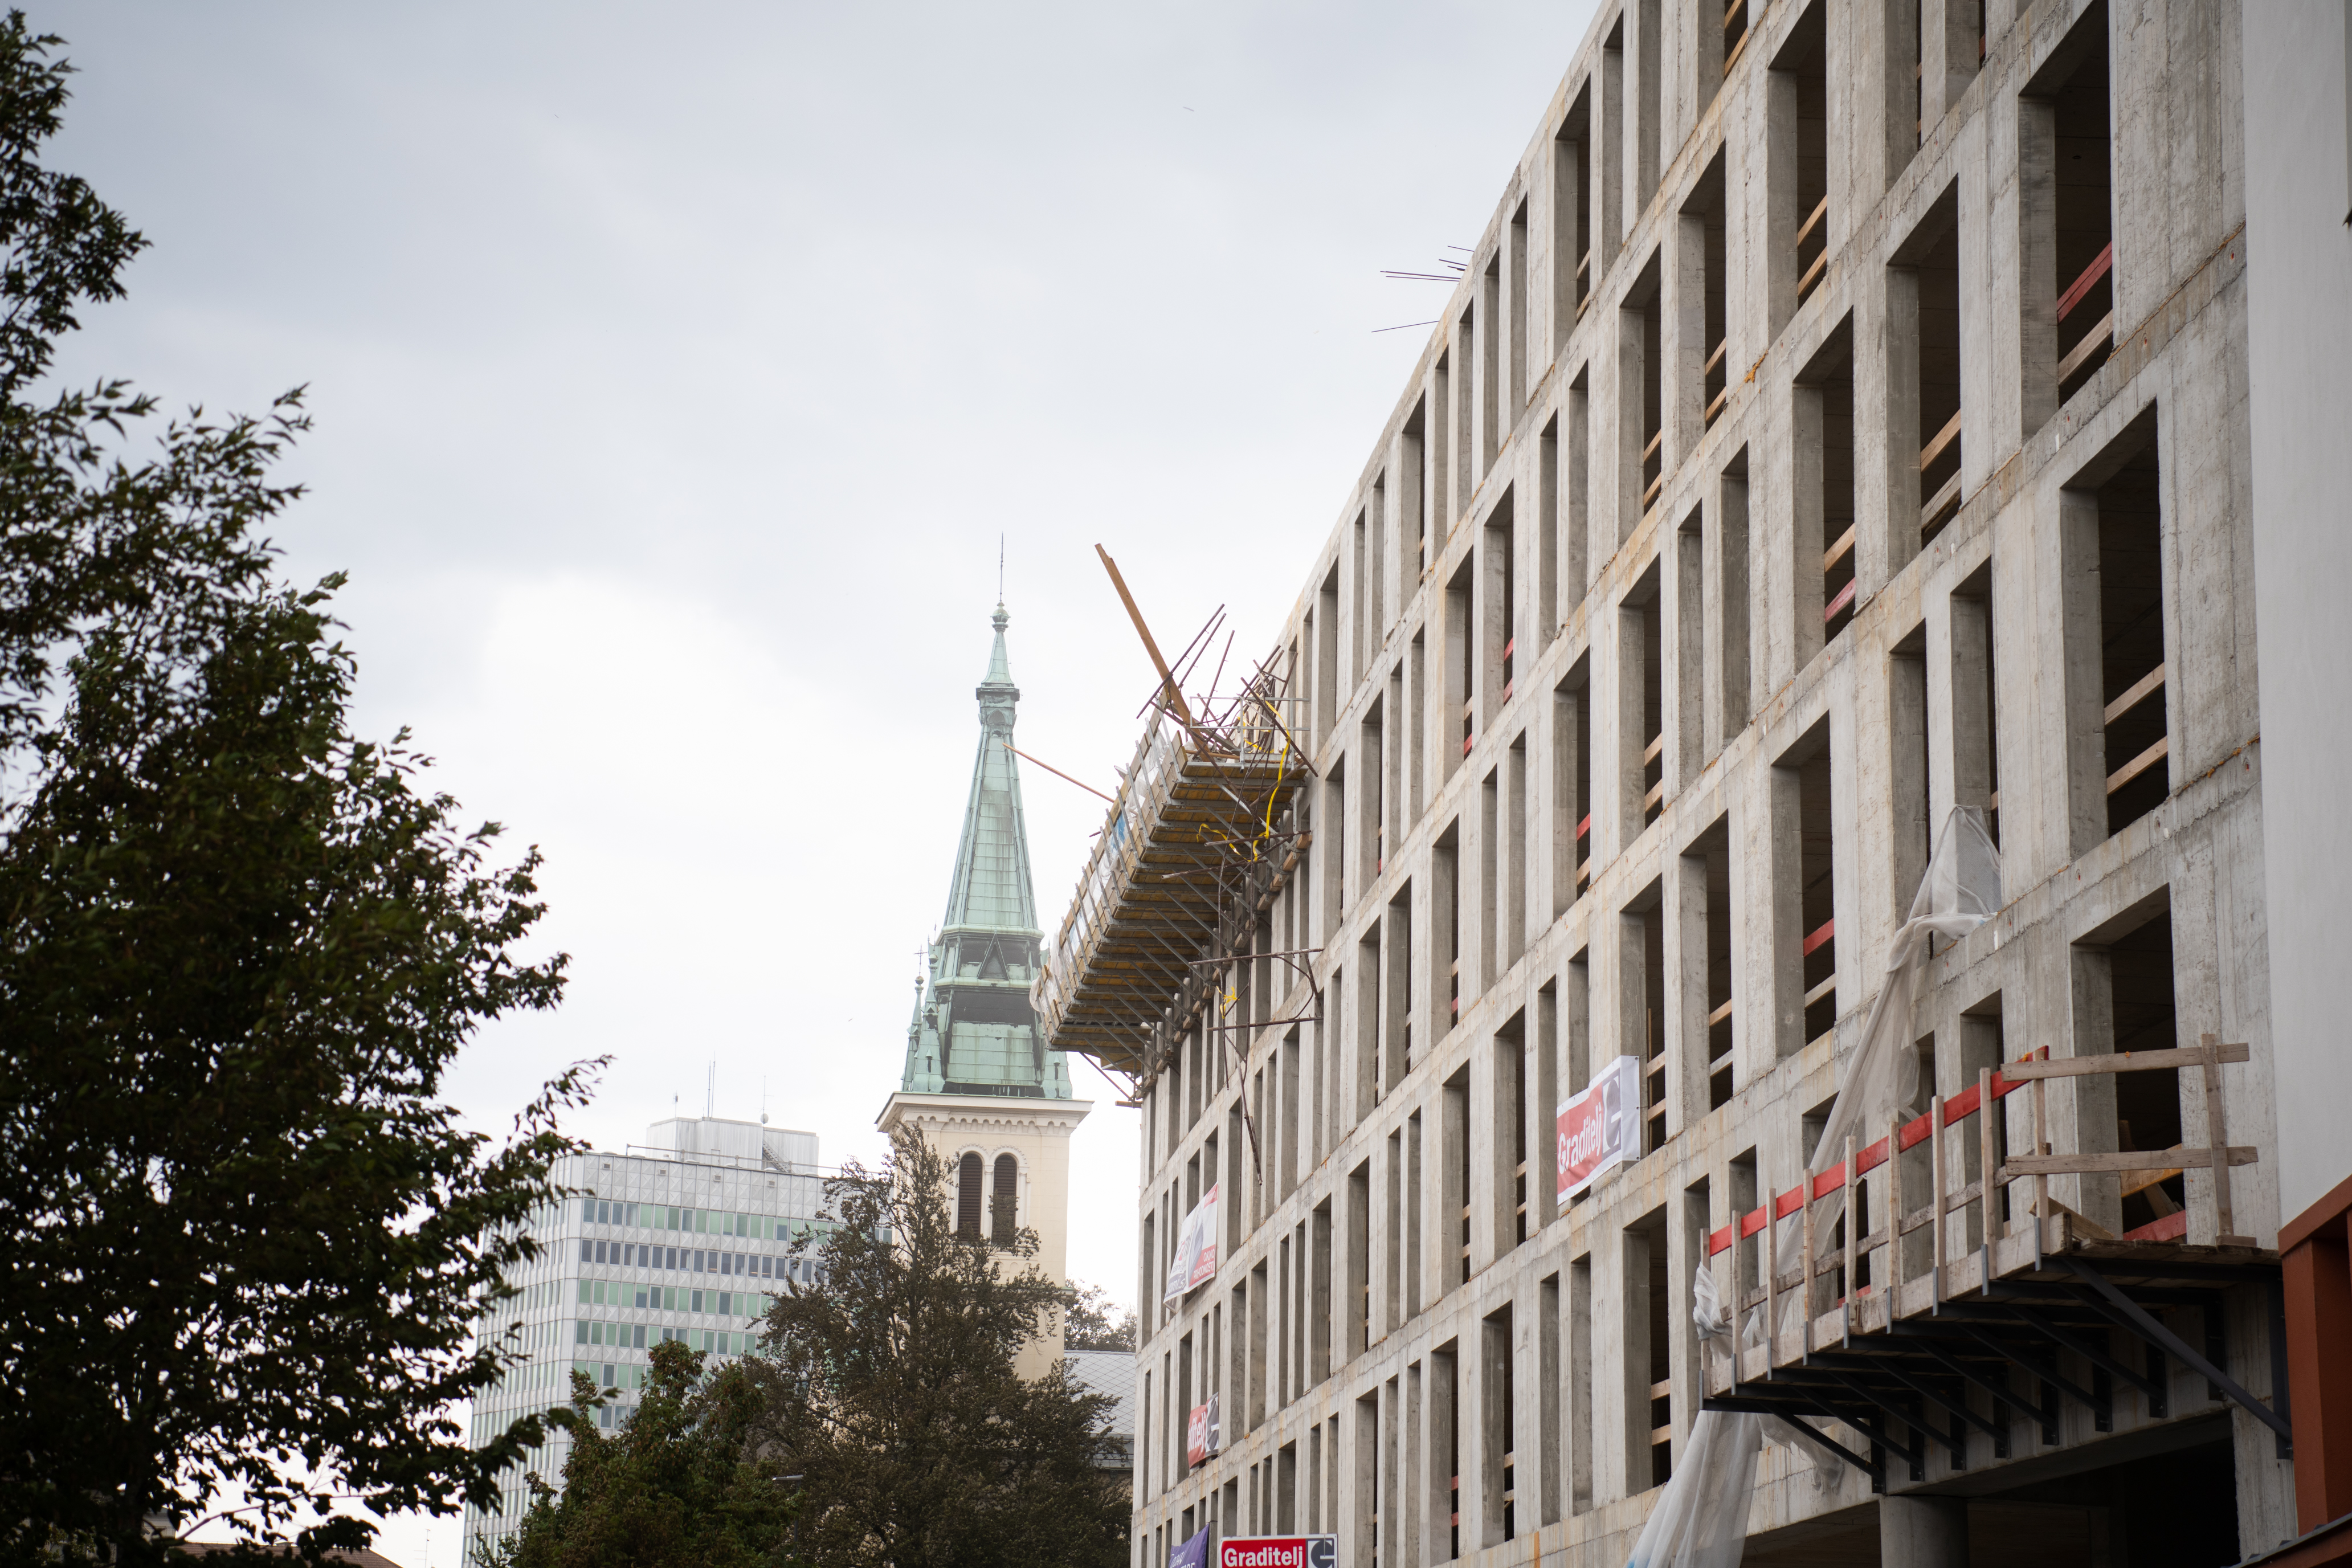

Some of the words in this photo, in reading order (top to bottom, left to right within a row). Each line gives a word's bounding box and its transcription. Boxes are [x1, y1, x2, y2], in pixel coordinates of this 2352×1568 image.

[1558, 1102, 1602, 1174] Graditelj
[1203, 1248, 1215, 1262] OKNO
[1193, 1260, 1214, 1281] PRIHODNOSTI
[1224, 1546, 1303, 1568] Graditelj
